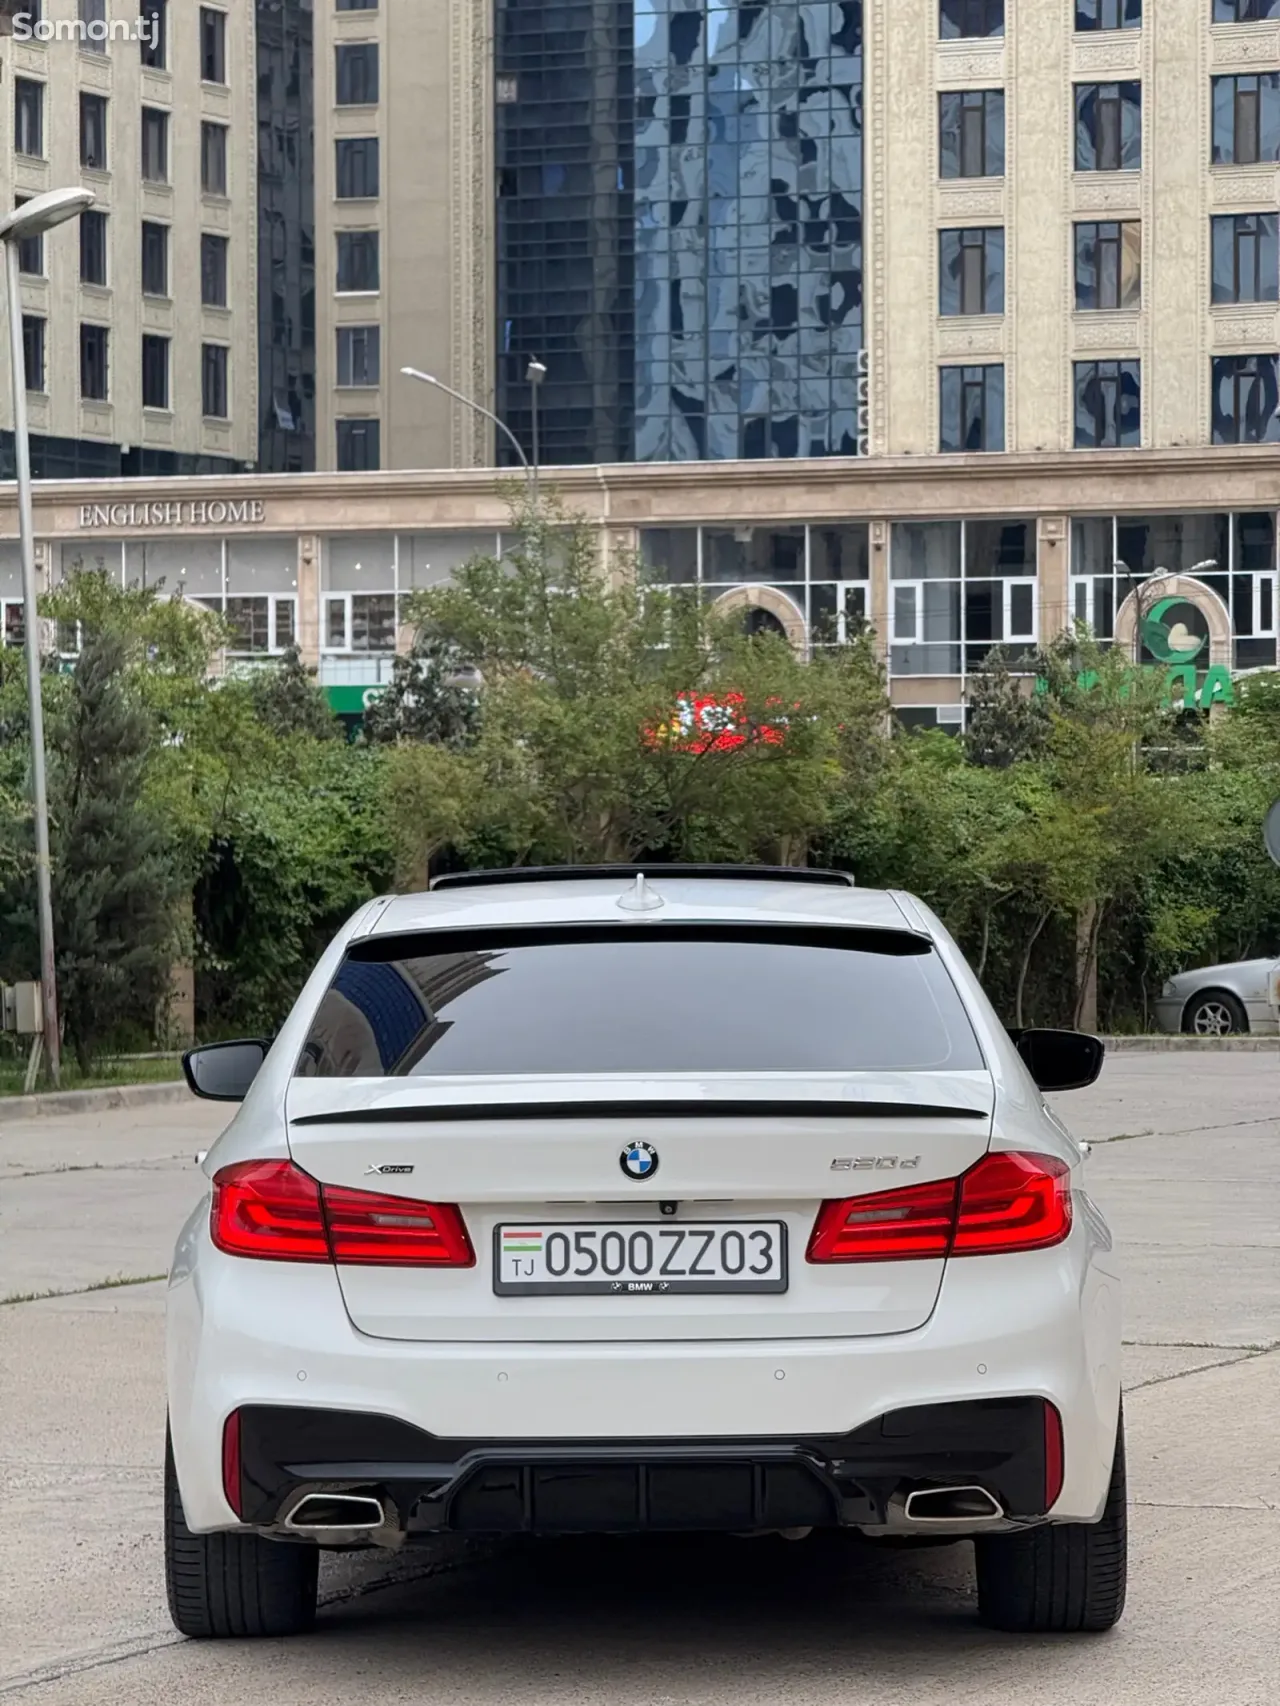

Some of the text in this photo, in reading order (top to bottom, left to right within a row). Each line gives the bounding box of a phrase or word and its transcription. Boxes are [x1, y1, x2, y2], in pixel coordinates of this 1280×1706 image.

[79, 500, 266, 528] ENGLISH HOME
[545, 1229, 773, 1277] 0500ZZ03
[511, 1258, 535, 1277] TJ
[627, 1282, 653, 1292] BMW
